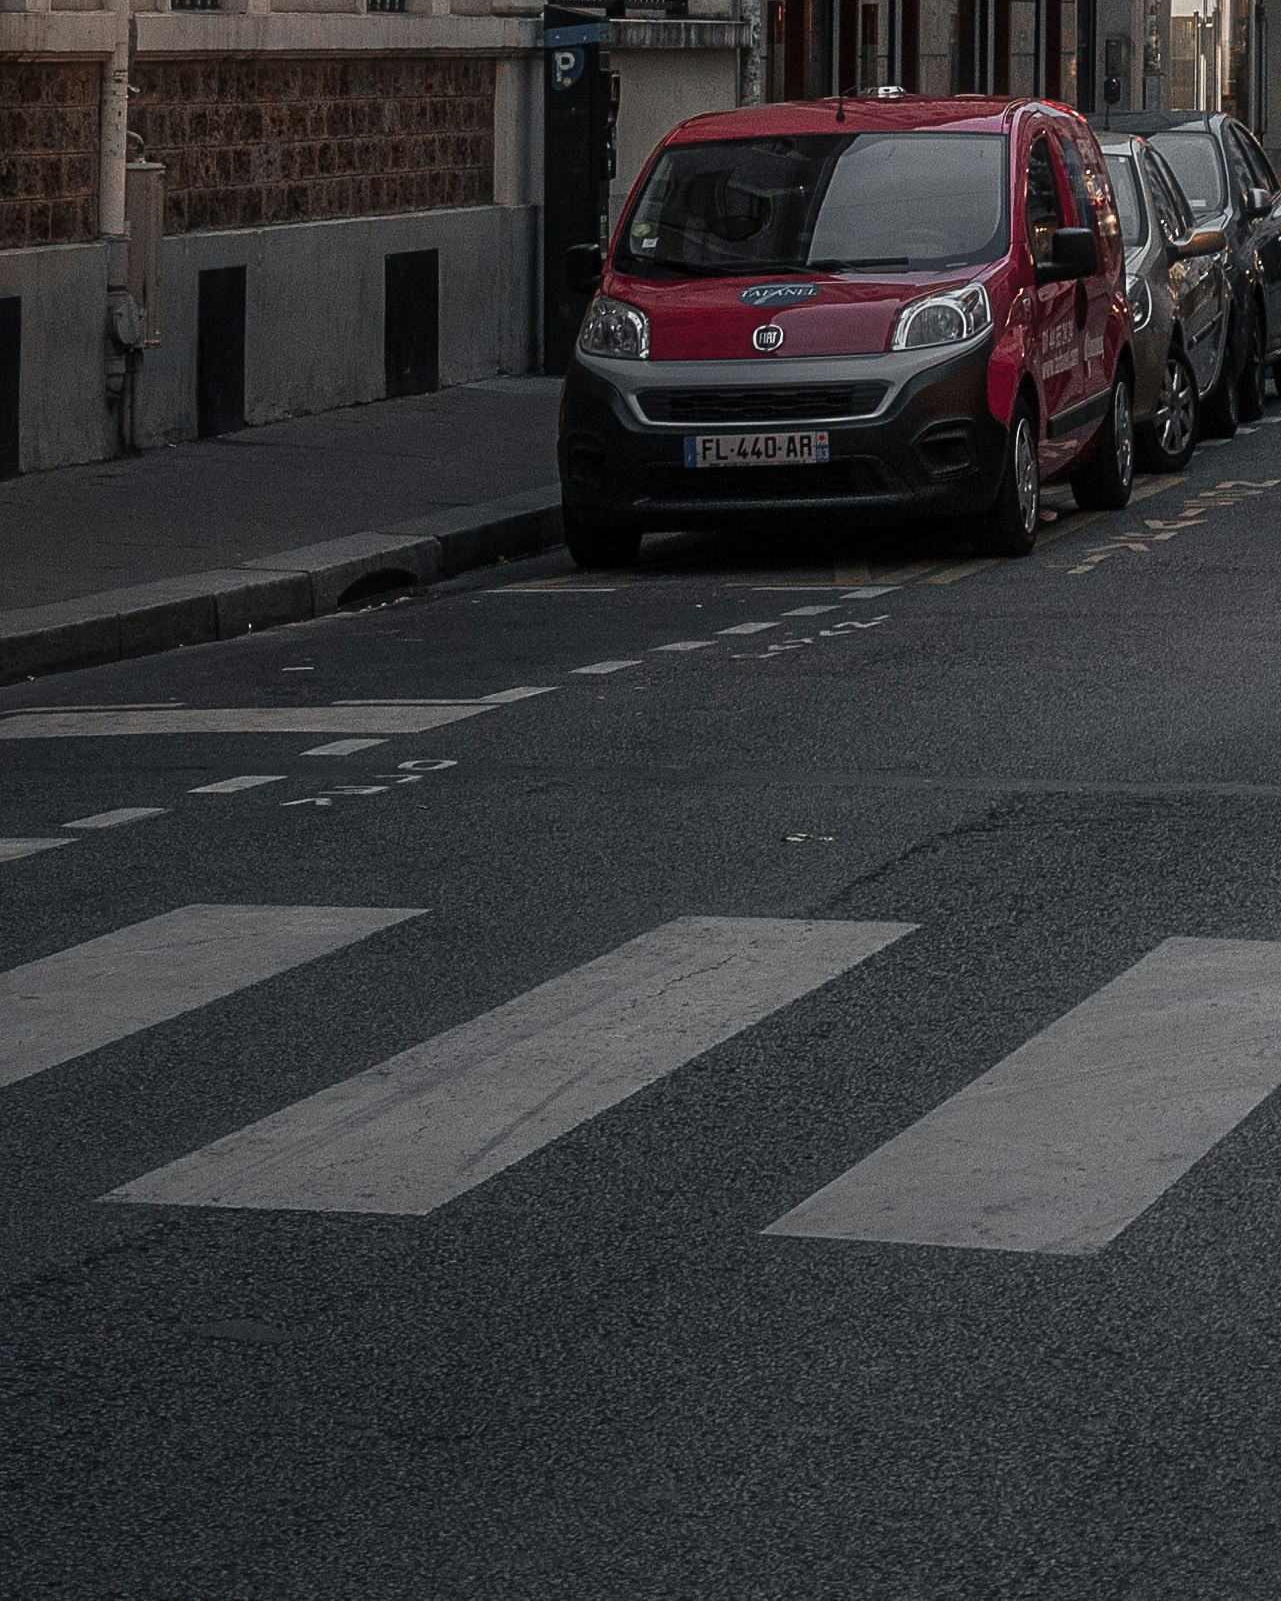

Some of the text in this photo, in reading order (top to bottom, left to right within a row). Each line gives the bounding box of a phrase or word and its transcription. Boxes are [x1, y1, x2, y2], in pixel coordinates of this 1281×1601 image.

[555, 52, 575, 83] P
[759, 331, 778, 344] FIAT
[702, 435, 813, 461] FL-440-AR
